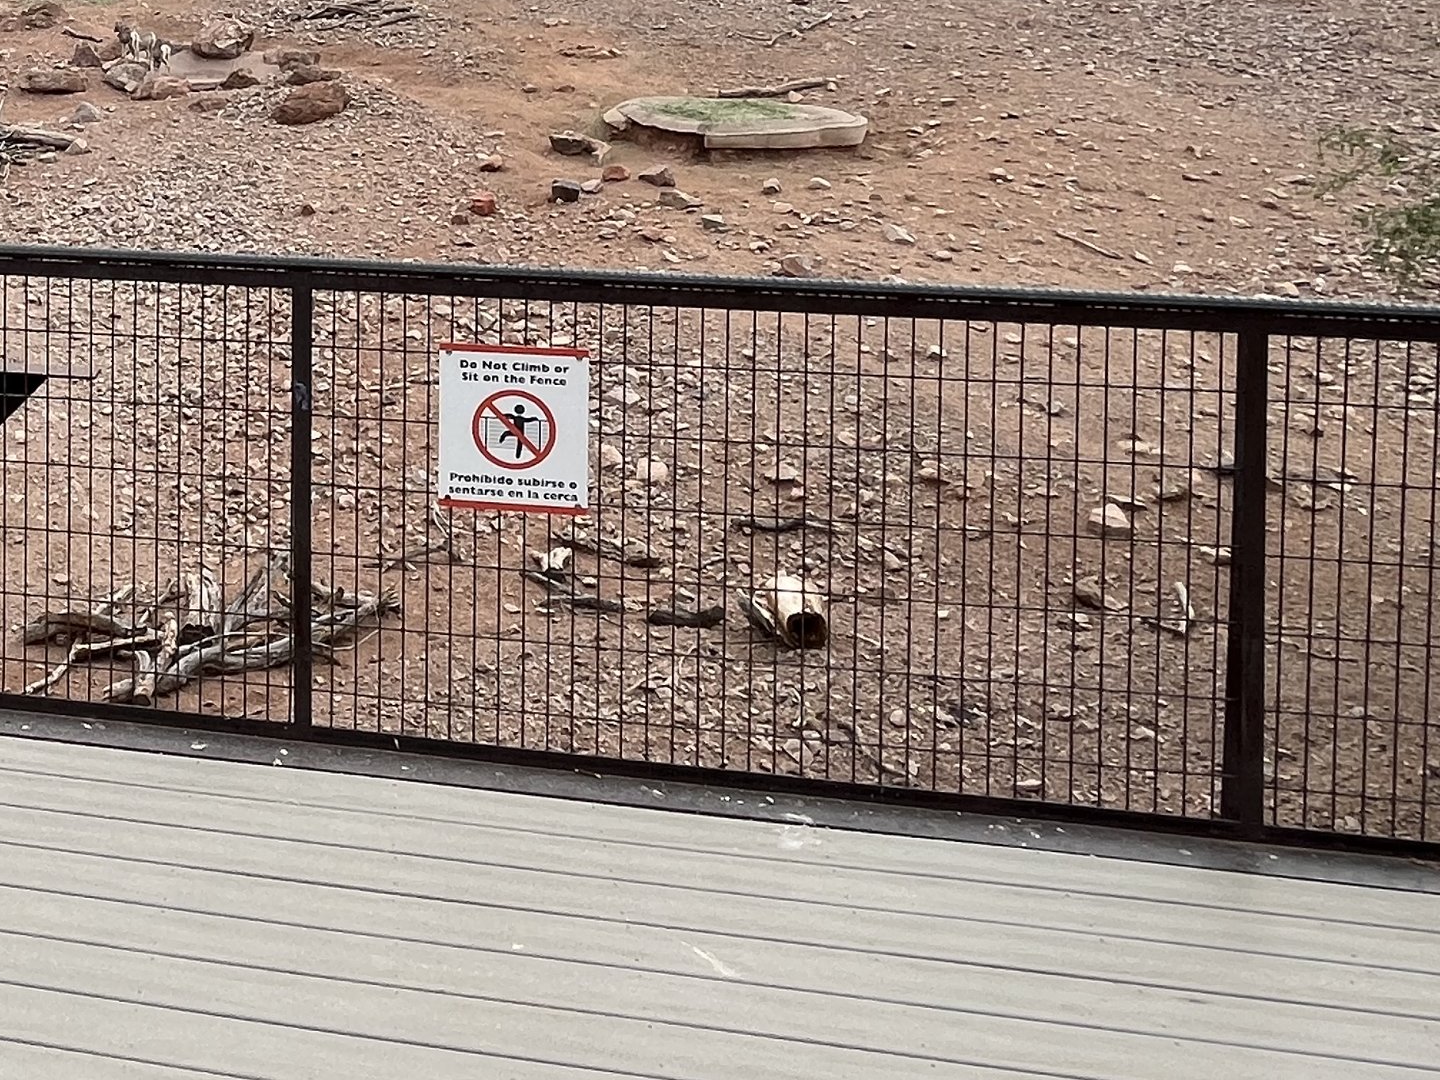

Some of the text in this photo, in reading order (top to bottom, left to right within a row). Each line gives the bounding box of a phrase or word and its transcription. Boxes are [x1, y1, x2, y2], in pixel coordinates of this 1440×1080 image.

[460, 360, 569, 374] Do Not Climb or
[462, 372, 567, 386] Sit on the Fence
[449, 472, 577, 489] Prohibido subirse o
[449, 486, 578, 502] sentarse en la cerca
